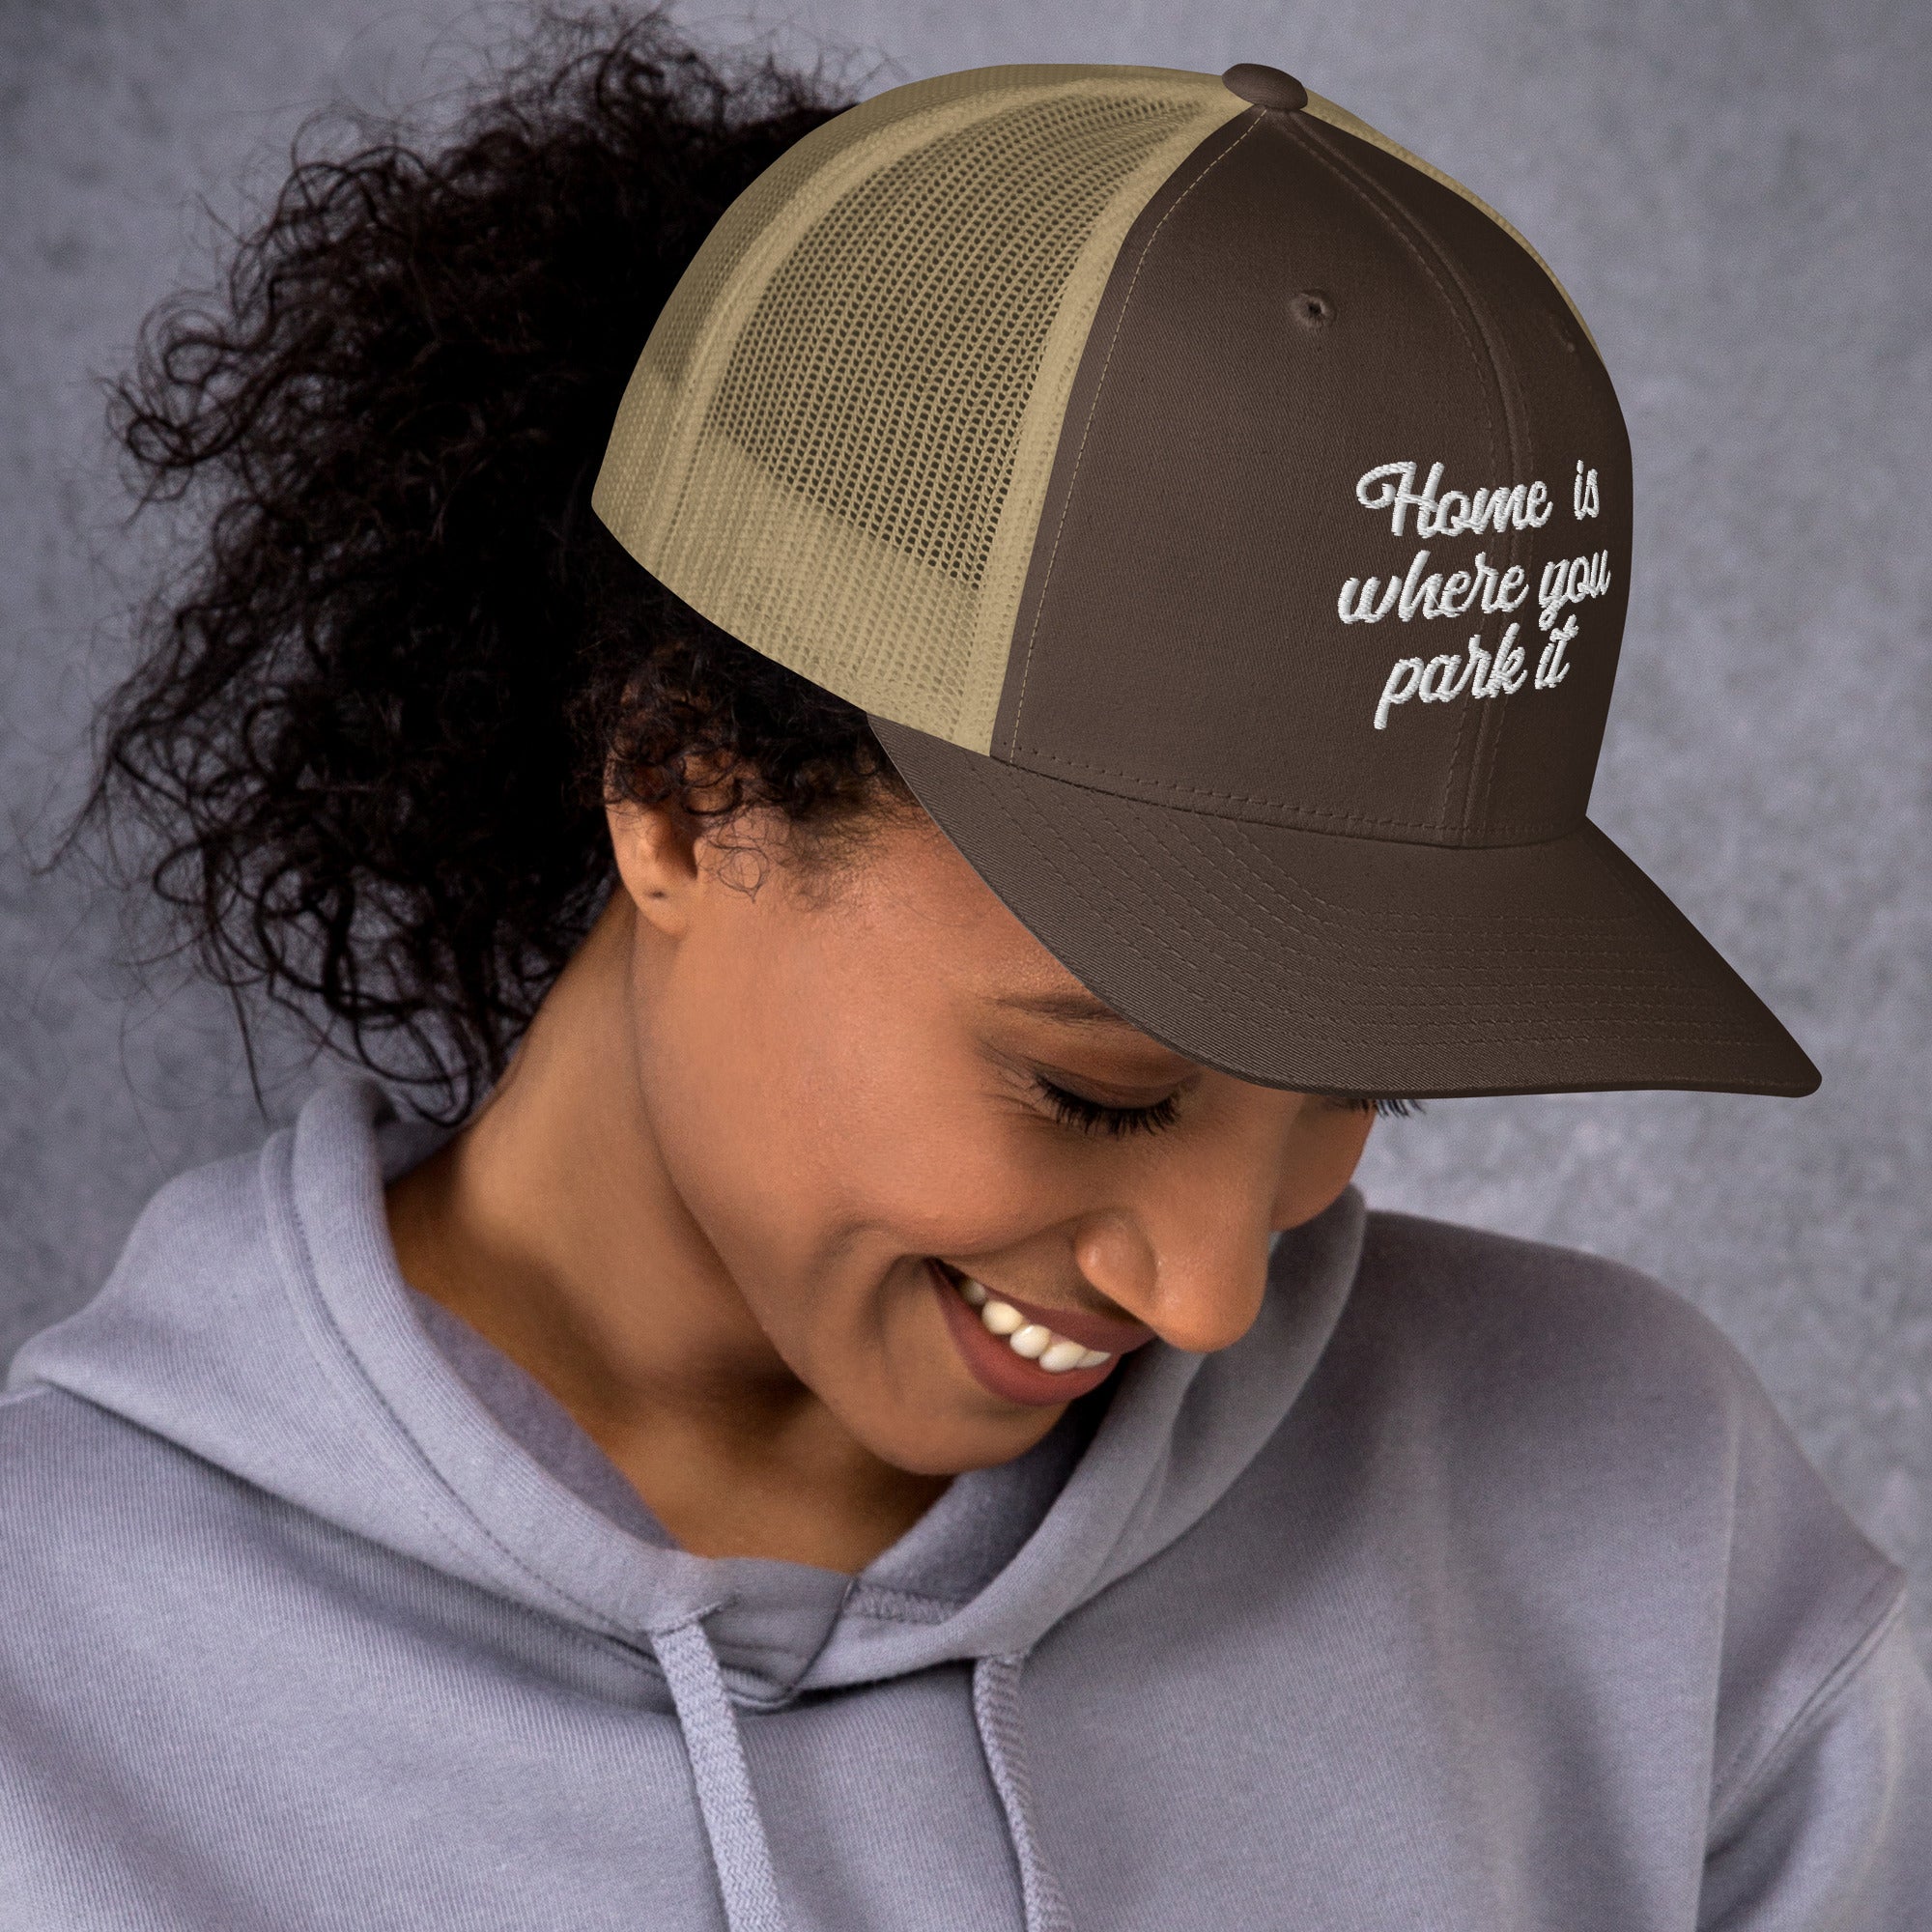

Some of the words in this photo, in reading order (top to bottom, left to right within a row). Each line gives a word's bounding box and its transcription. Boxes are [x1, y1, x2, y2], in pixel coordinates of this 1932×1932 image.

[1355, 461, 1553, 538] Home
[1574, 459, 1600, 521] is
[1337, 550, 1529, 624] where
[1538, 549, 1610, 631] you
[1373, 622, 1528, 729] park
[1534, 614, 1579, 690] it
